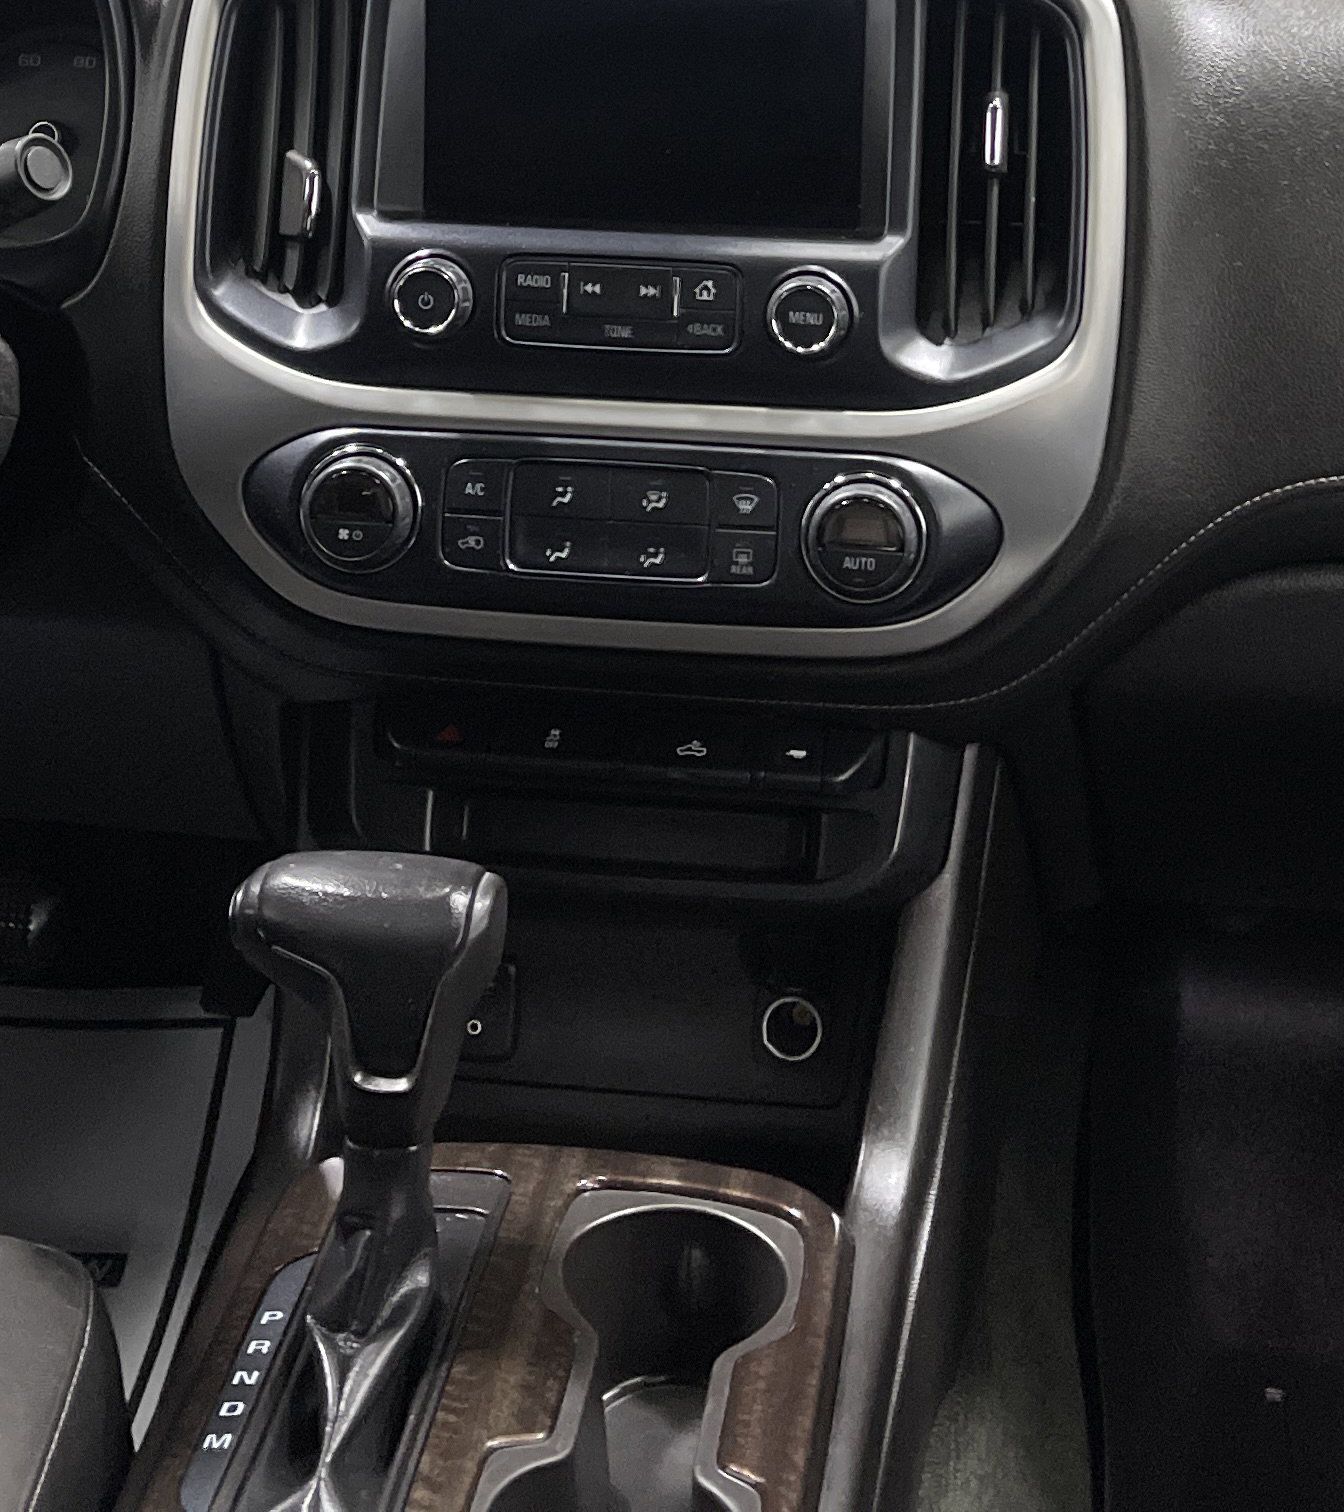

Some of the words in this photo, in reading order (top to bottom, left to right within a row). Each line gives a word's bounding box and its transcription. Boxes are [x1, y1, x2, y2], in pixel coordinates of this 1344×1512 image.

[517, 273, 552, 288] RADIO
[514, 313, 551, 327] MEDIA
[788, 310, 824, 326] MENU
[604, 324, 635, 339] TONE
[693, 323, 724, 337] BACK
[464, 482, 486, 496] A/C
[842, 556, 876, 571] AUTO
[260, 1311, 283, 1324] P
[247, 1340, 271, 1354] R
[231, 1371, 259, 1385] N
[219, 1402, 245, 1416] D
[203, 1434, 232, 1449] M
